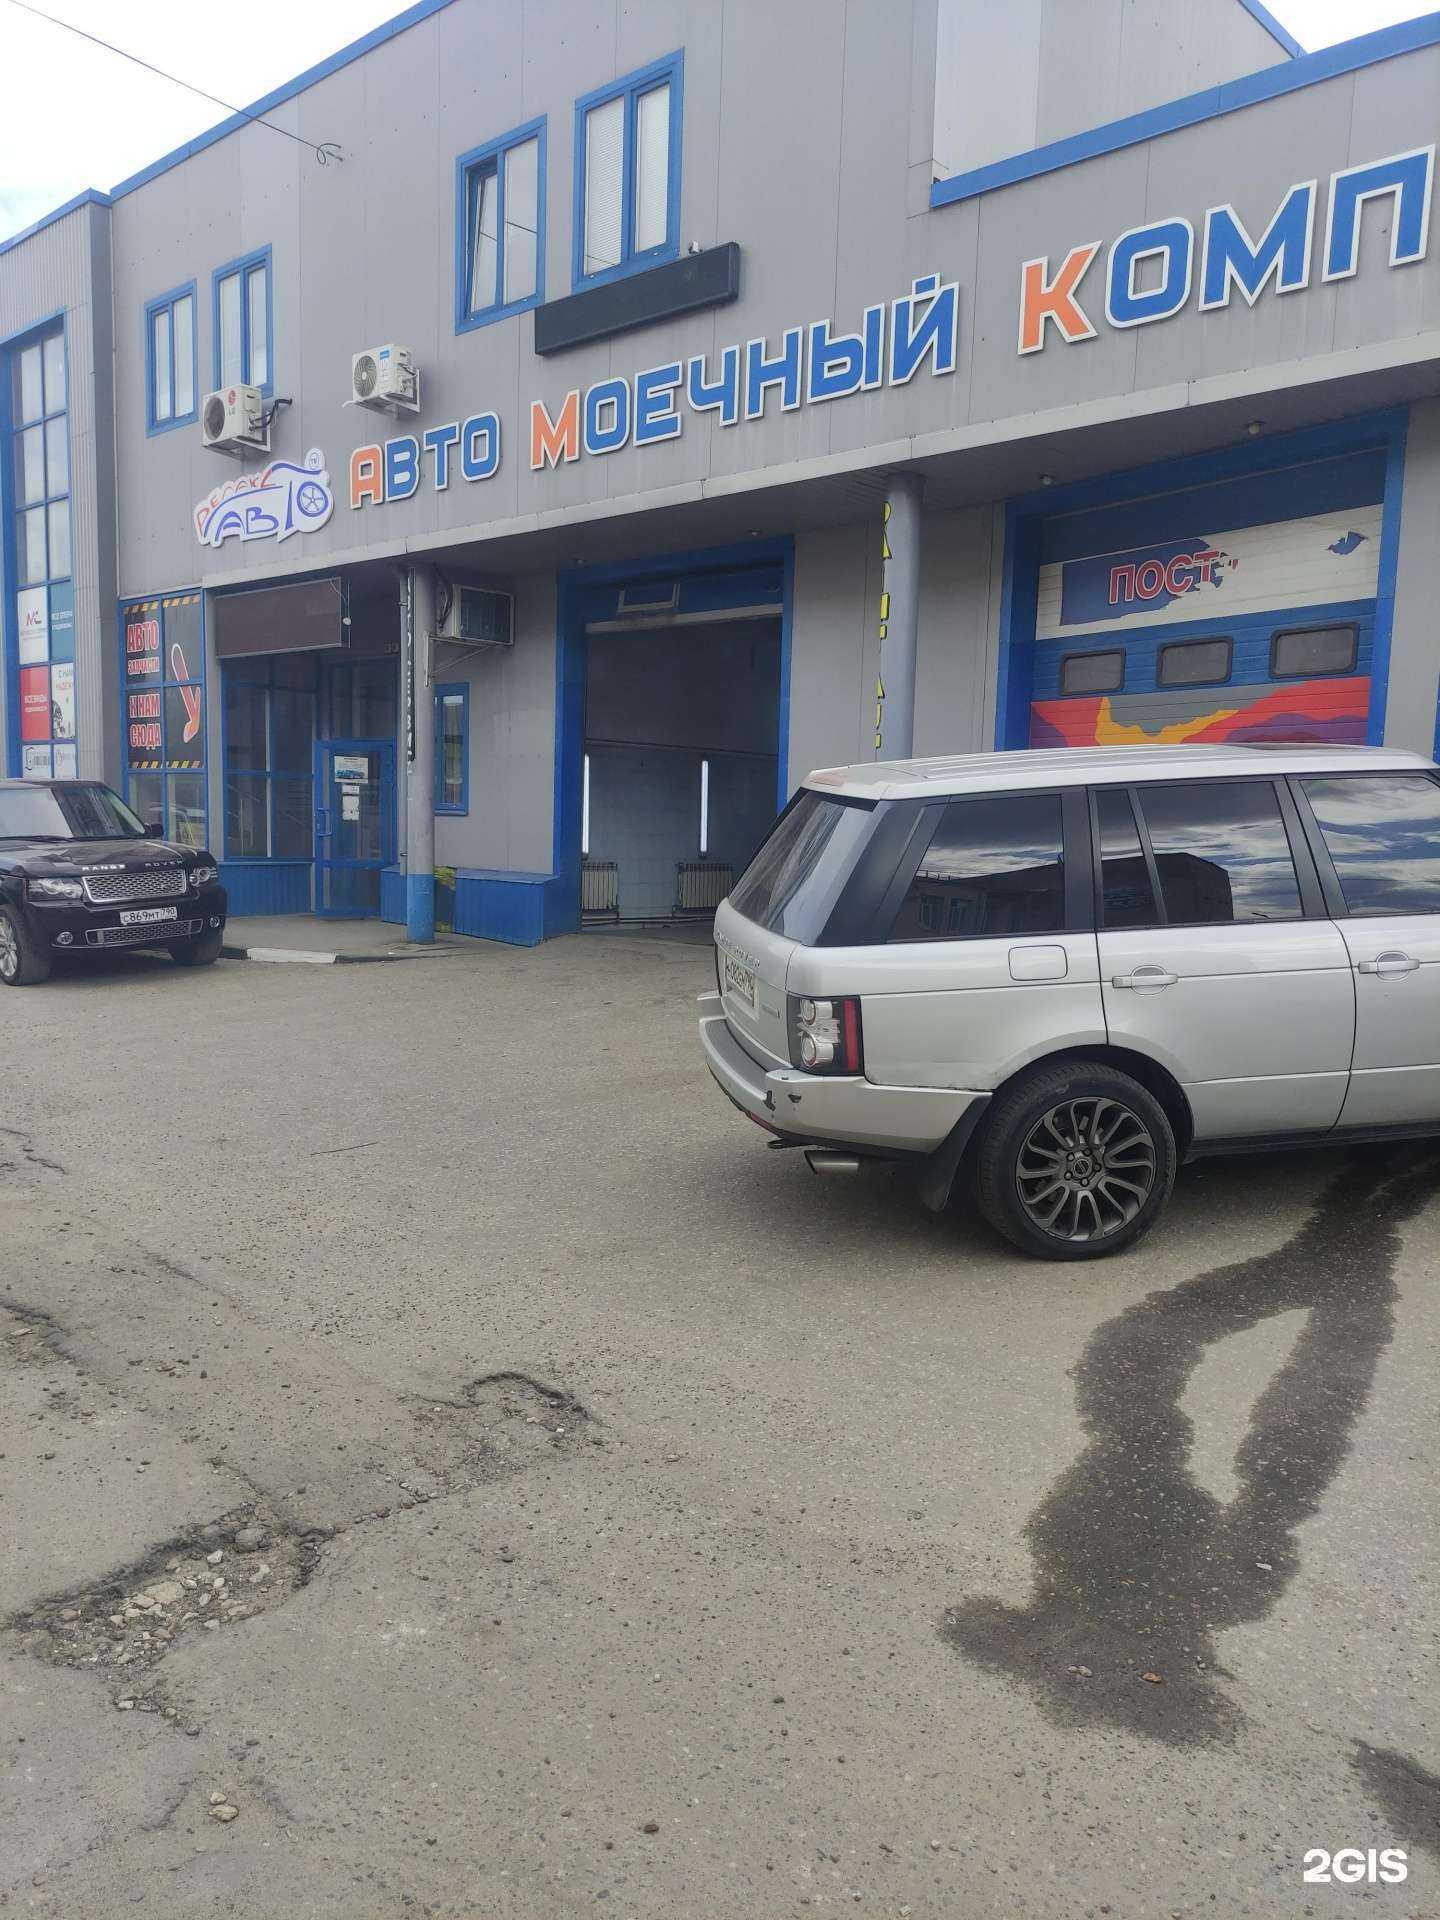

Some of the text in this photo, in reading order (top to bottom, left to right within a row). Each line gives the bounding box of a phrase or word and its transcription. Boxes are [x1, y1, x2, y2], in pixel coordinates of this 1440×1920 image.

[350, 143, 1436, 508] АВТО МОЕЧНЫЙ КОМП
[1109, 551, 1220, 604] ПОСТ
[126, 620, 160, 653] АВТО
[127, 656, 160, 675] ЗАПЧАСТИ
[138, 693, 161, 718] НАМ
[130, 723, 162, 750] СЮДА
